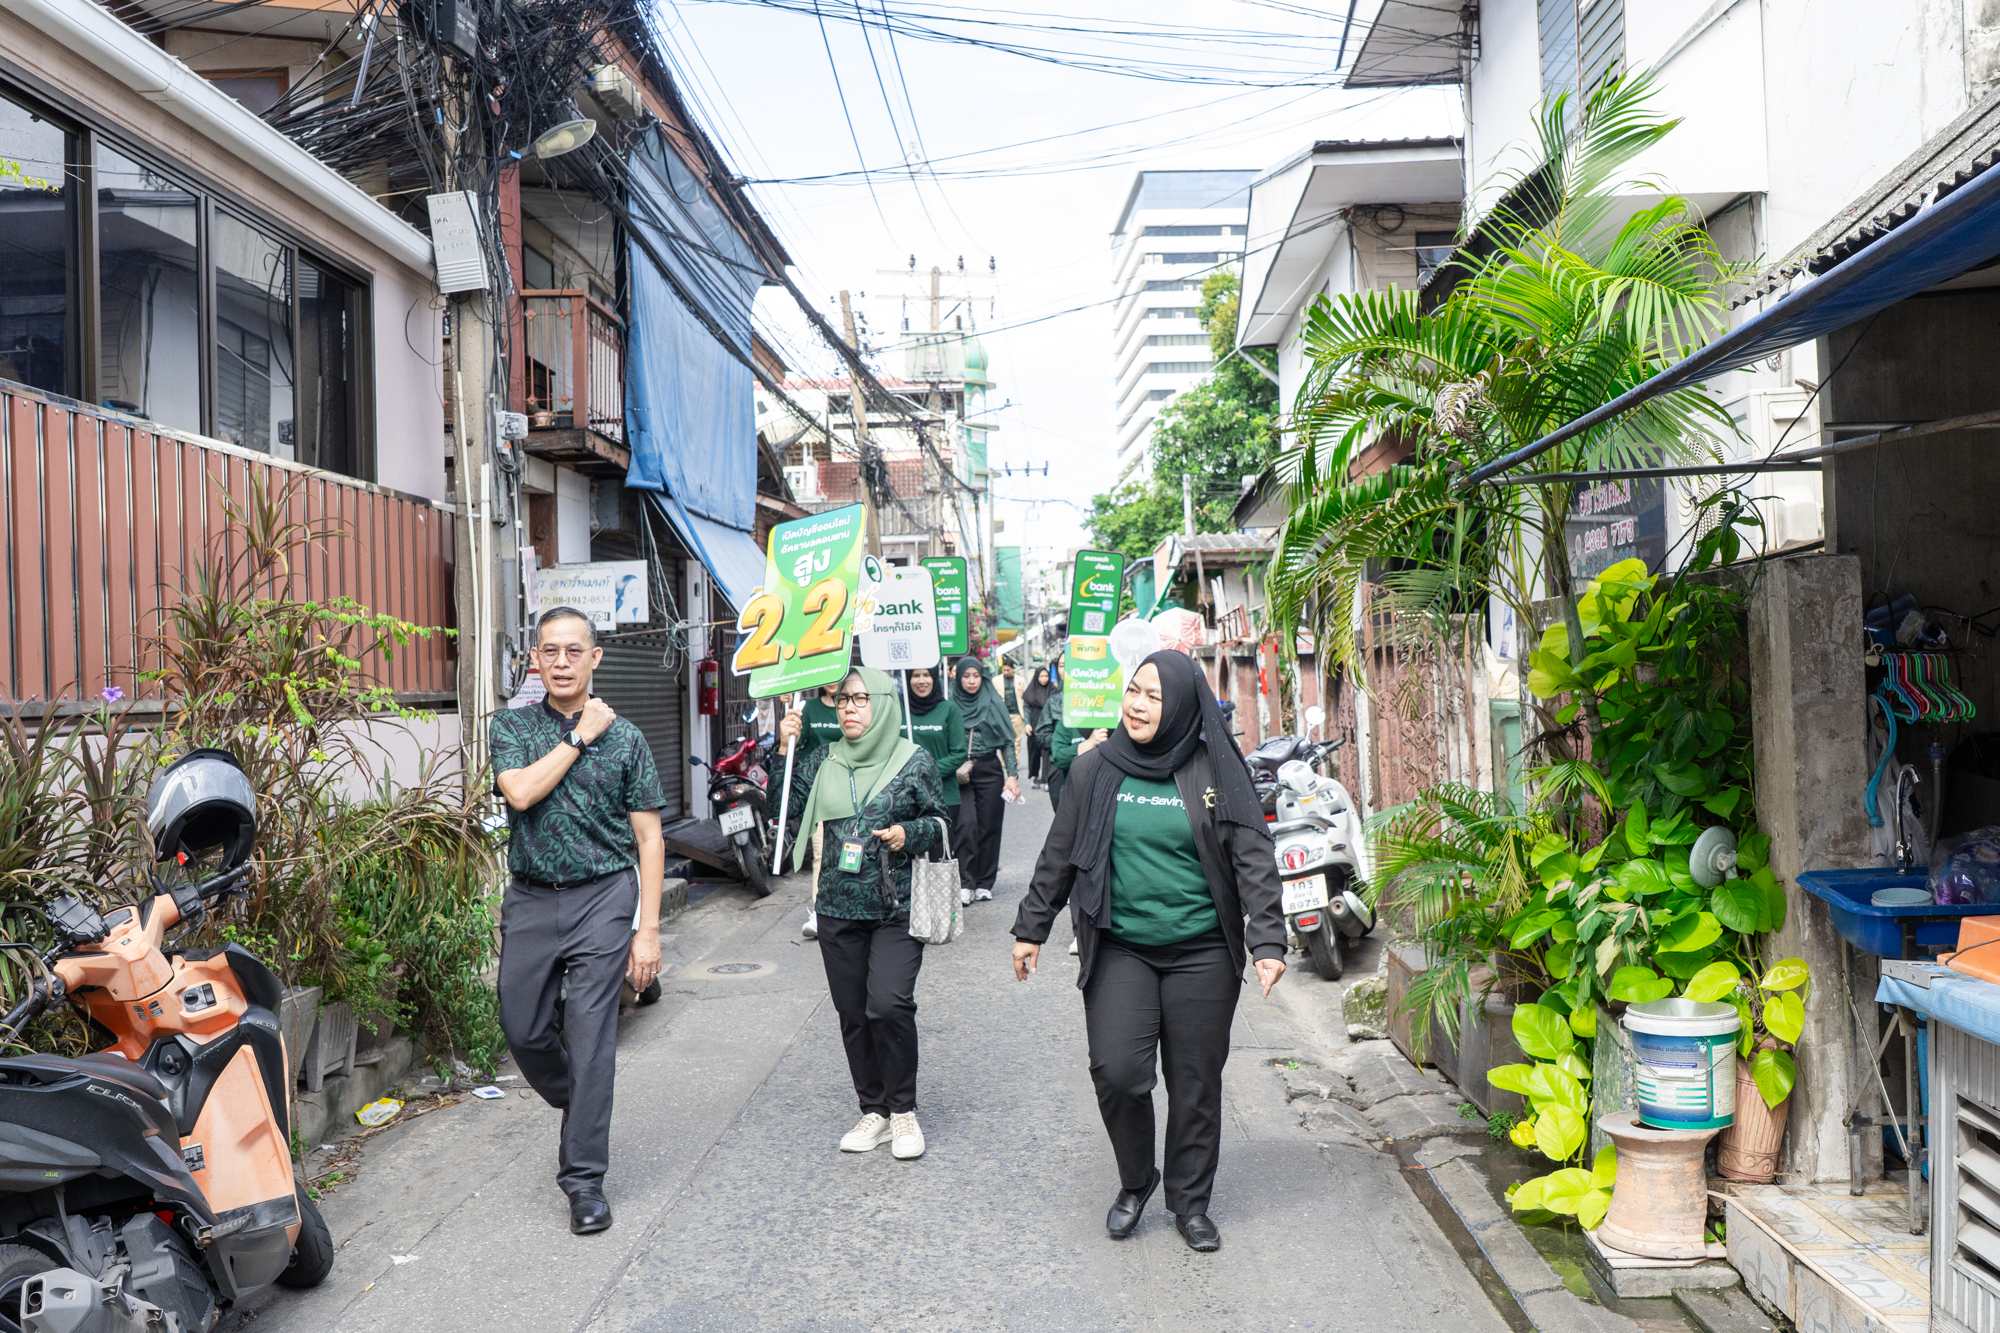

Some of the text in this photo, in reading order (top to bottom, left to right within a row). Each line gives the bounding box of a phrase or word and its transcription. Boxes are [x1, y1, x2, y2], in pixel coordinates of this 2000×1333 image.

[782, 514, 851, 541] เปิดบัญชีออนไลน์
[780, 530, 851, 554] อัตราผลตอบแทน
[1584, 526, 1608, 554] 2392
[1611, 518, 1635, 546] 7173
[793, 548, 831, 588] สูง
[873, 621, 923, 634] ใครๆก็ใช้ได้
[1077, 643, 1101, 653] พิเศษ
[1070, 668, 1109, 680] เปิดบัญชี
[1070, 680, 1116, 690] ภายในงาน
[1070, 694, 1106, 708] รับฟรี
[1289, 897, 1320, 911] 8975
